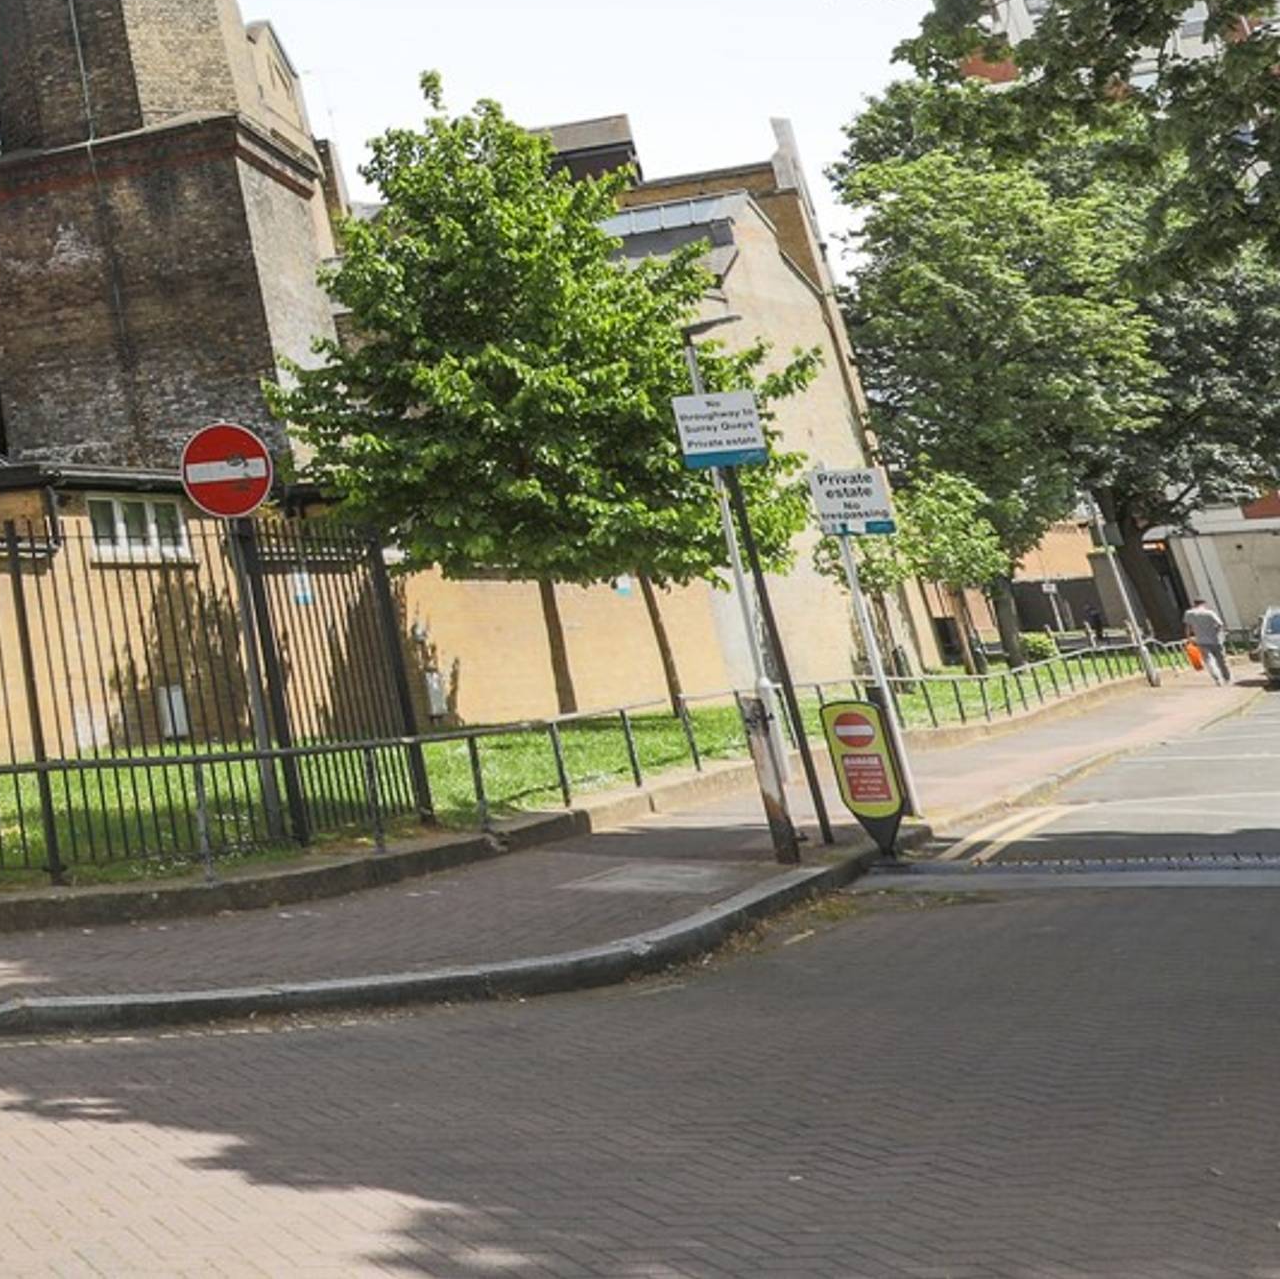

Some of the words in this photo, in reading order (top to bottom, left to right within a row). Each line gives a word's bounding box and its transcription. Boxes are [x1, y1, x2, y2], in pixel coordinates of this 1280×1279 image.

[679, 410, 740, 422] throughway
[742, 408, 754, 416] to
[684, 424, 718, 434] Surrey
[721, 422, 754, 431] Quays
[687, 439, 723, 449] Private
[726, 436, 757, 446] estate
[817, 473, 873, 486] Private
[826, 486, 873, 499] estate
[843, 501, 861, 510] No
[821, 509, 890, 520] trespassing
